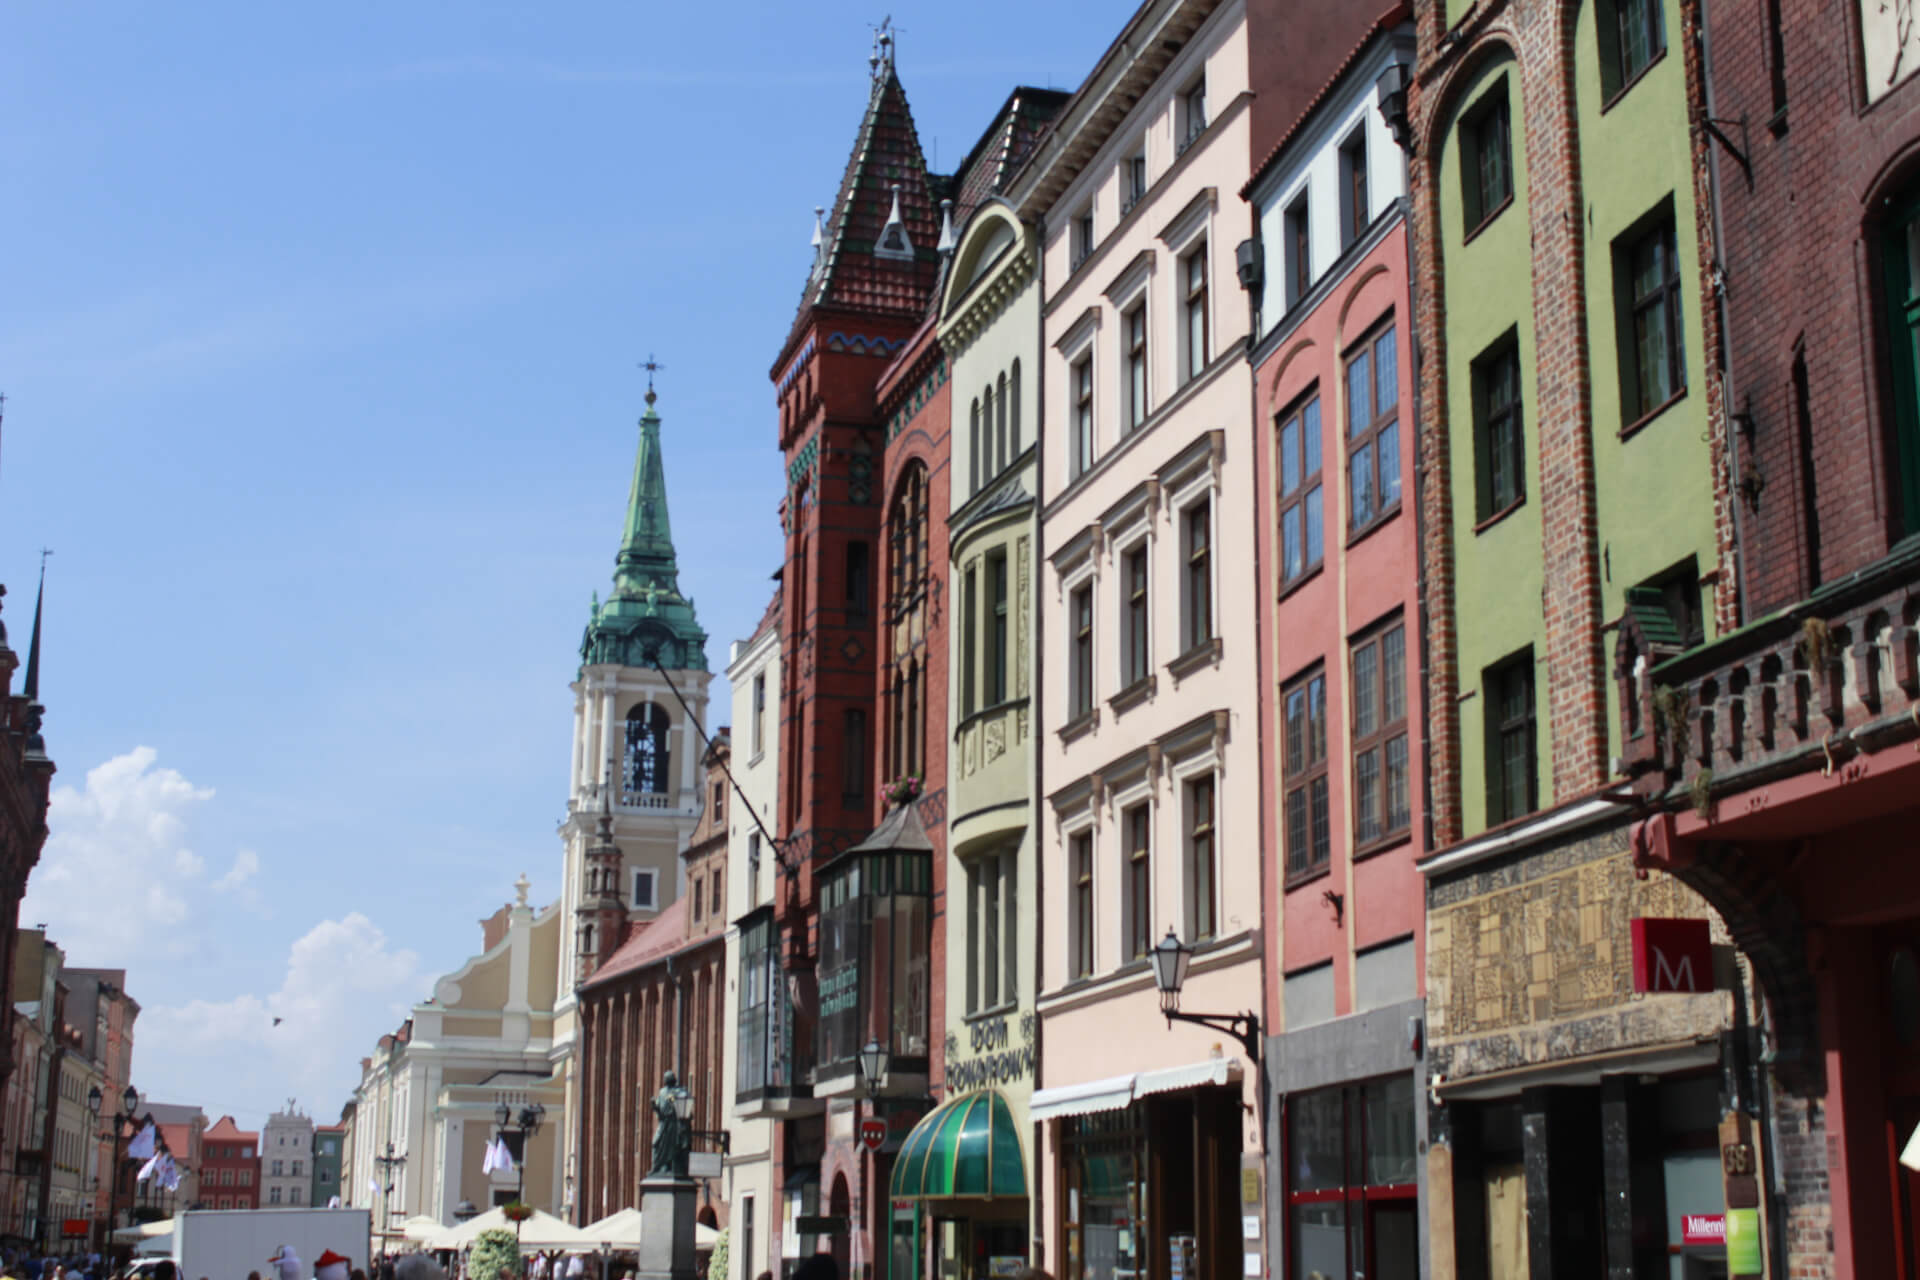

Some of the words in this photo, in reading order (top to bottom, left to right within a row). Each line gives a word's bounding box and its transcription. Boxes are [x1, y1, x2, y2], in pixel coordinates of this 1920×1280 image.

[1652, 945, 1696, 992] M
[970, 1017, 1008, 1054] DOM
[944, 1045, 1036, 1094] TOWAROWY
